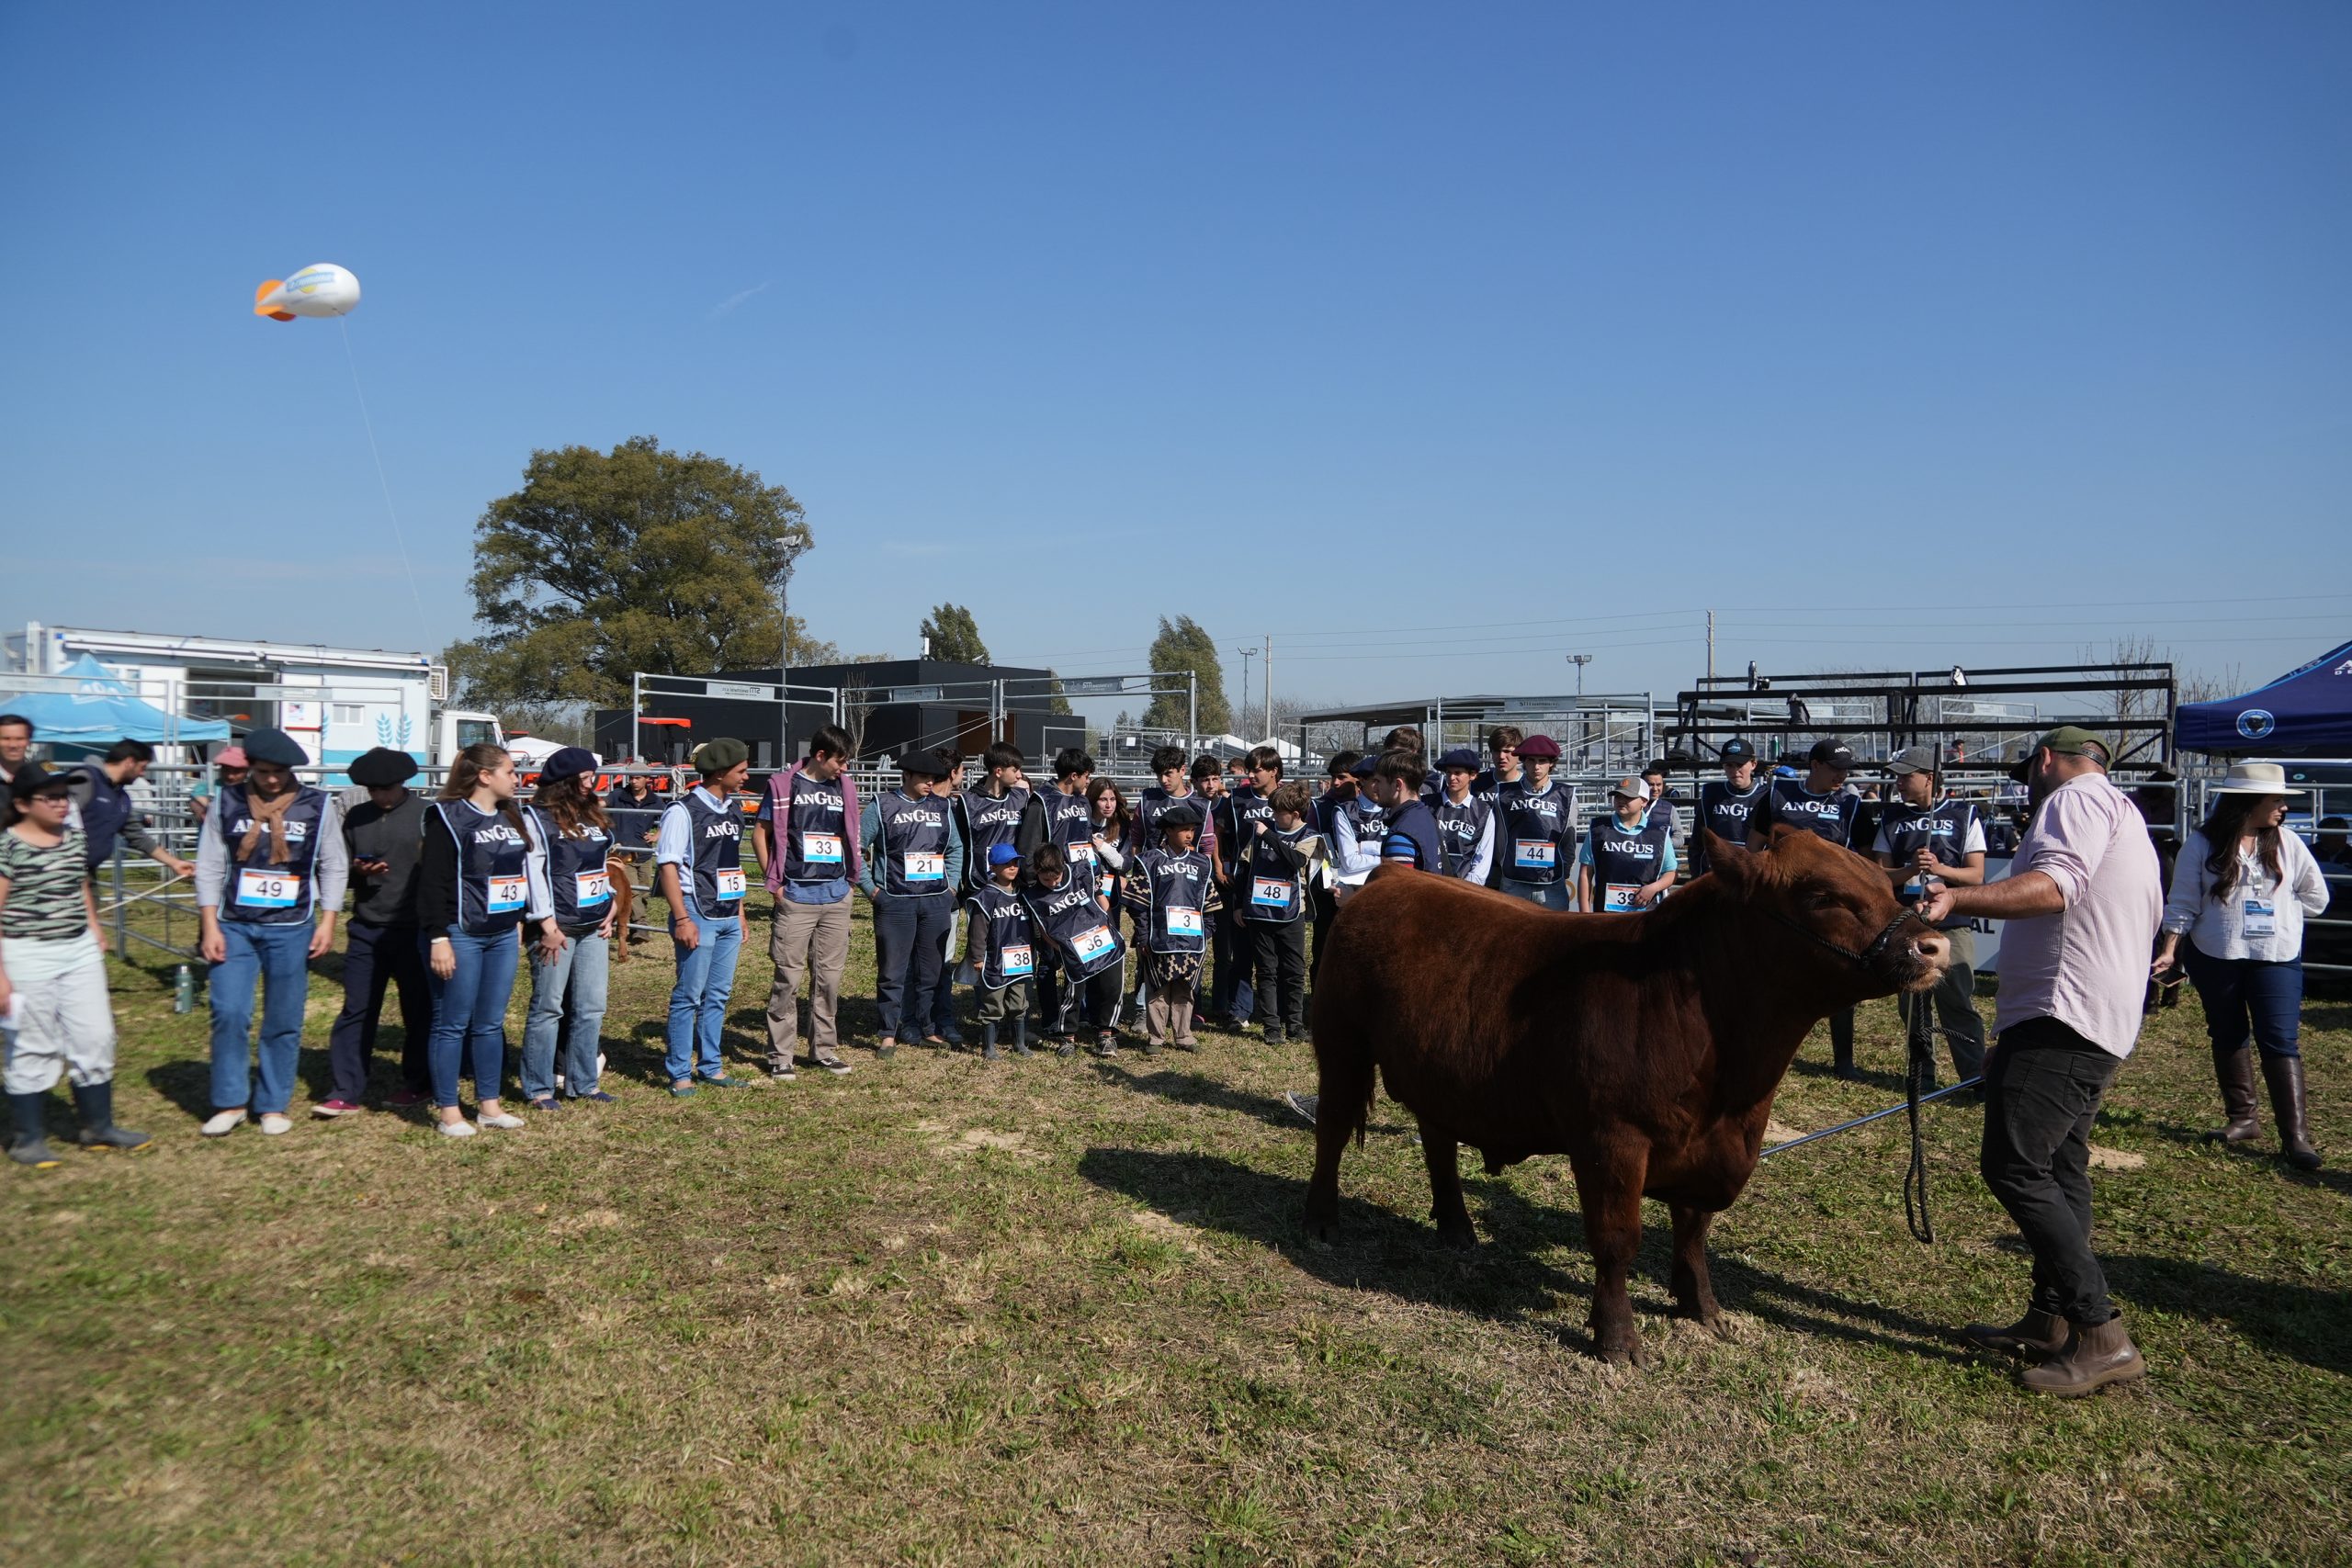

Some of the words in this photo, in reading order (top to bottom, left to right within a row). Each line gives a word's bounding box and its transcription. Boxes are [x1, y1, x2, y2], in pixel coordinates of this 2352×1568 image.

[793, 791, 844, 807] ANGUS
[1510, 797, 1557, 813] ANGUS
[1057, 805, 1087, 821] ANGUS
[1243, 806, 1275, 821] ANG
[1781, 800, 1840, 815] ANGUS
[893, 809, 942, 824] ANGUS
[979, 808, 1022, 824] ANGUS
[1438, 819, 1476, 836] NGUS
[1894, 817, 1954, 834] ANGUS
[474, 824, 521, 843] ANGUS
[815, 840, 832, 855] 33
[1526, 847, 1544, 860] 44
[1601, 840, 1654, 854] ANGUS
[1077, 850, 1089, 862] 32
[916, 860, 933, 873] 21
[1156, 862, 1199, 876] ANGUS
[255, 880, 282, 897] 49
[590, 879, 604, 897] 27
[727, 876, 740, 891] 15
[501, 884, 517, 901] 43
[1263, 886, 1281, 899] 48
[1617, 892, 1635, 905] 39
[1047, 887, 1088, 916] ANGUS
[1182, 915, 1191, 928] 3
[1084, 934, 1102, 952] 36
[1013, 952, 1030, 966] 38
